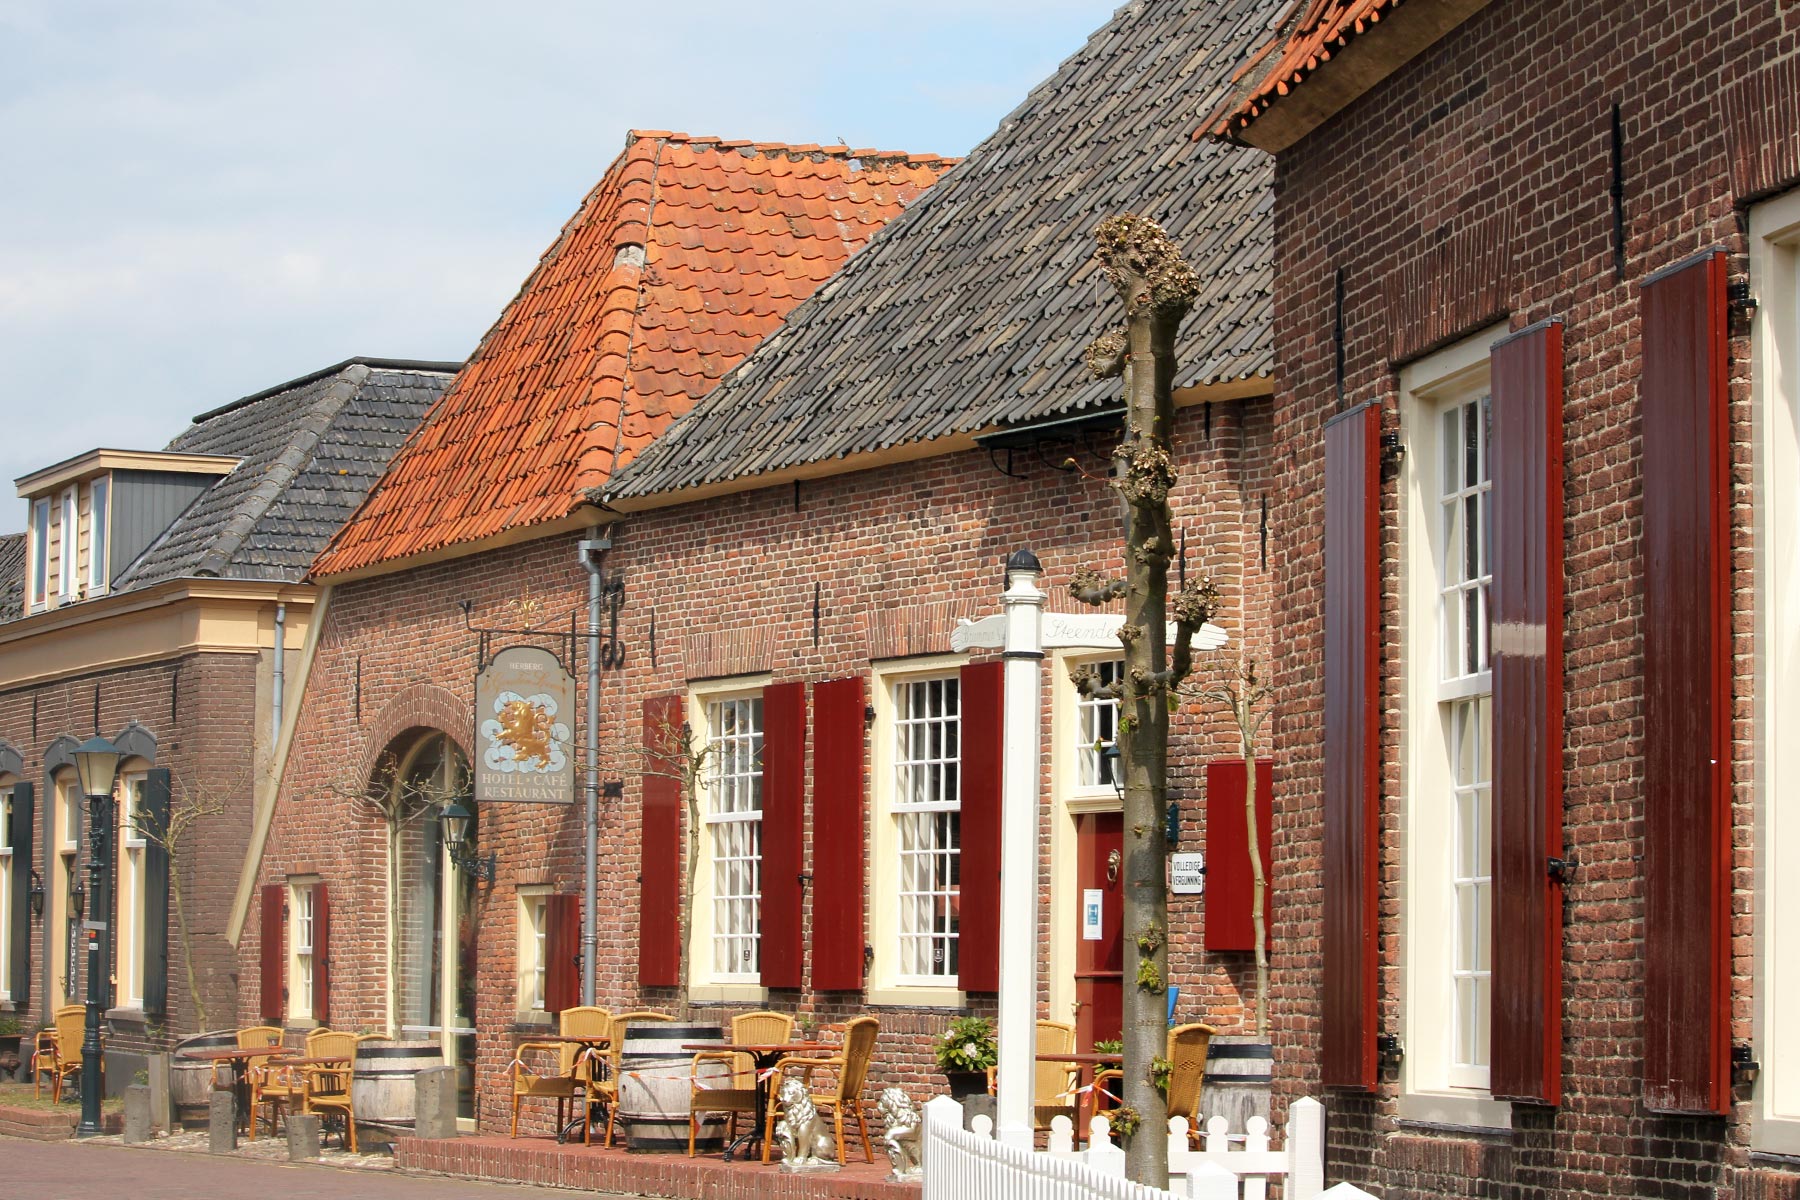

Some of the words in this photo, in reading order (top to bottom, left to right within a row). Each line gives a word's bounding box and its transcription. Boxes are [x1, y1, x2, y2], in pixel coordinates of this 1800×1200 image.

[1046, 619, 1117, 640] Steende
[509, 662, 543, 671] HERBERG
[482, 773, 524, 785] HOTEL
[533, 773, 568, 787] CAFÉ
[484, 786, 566, 800] RESTAURANT
[1173, 861, 1201, 872] VOLLEDIGE
[1173, 875, 1201, 886] VERGUNNING
